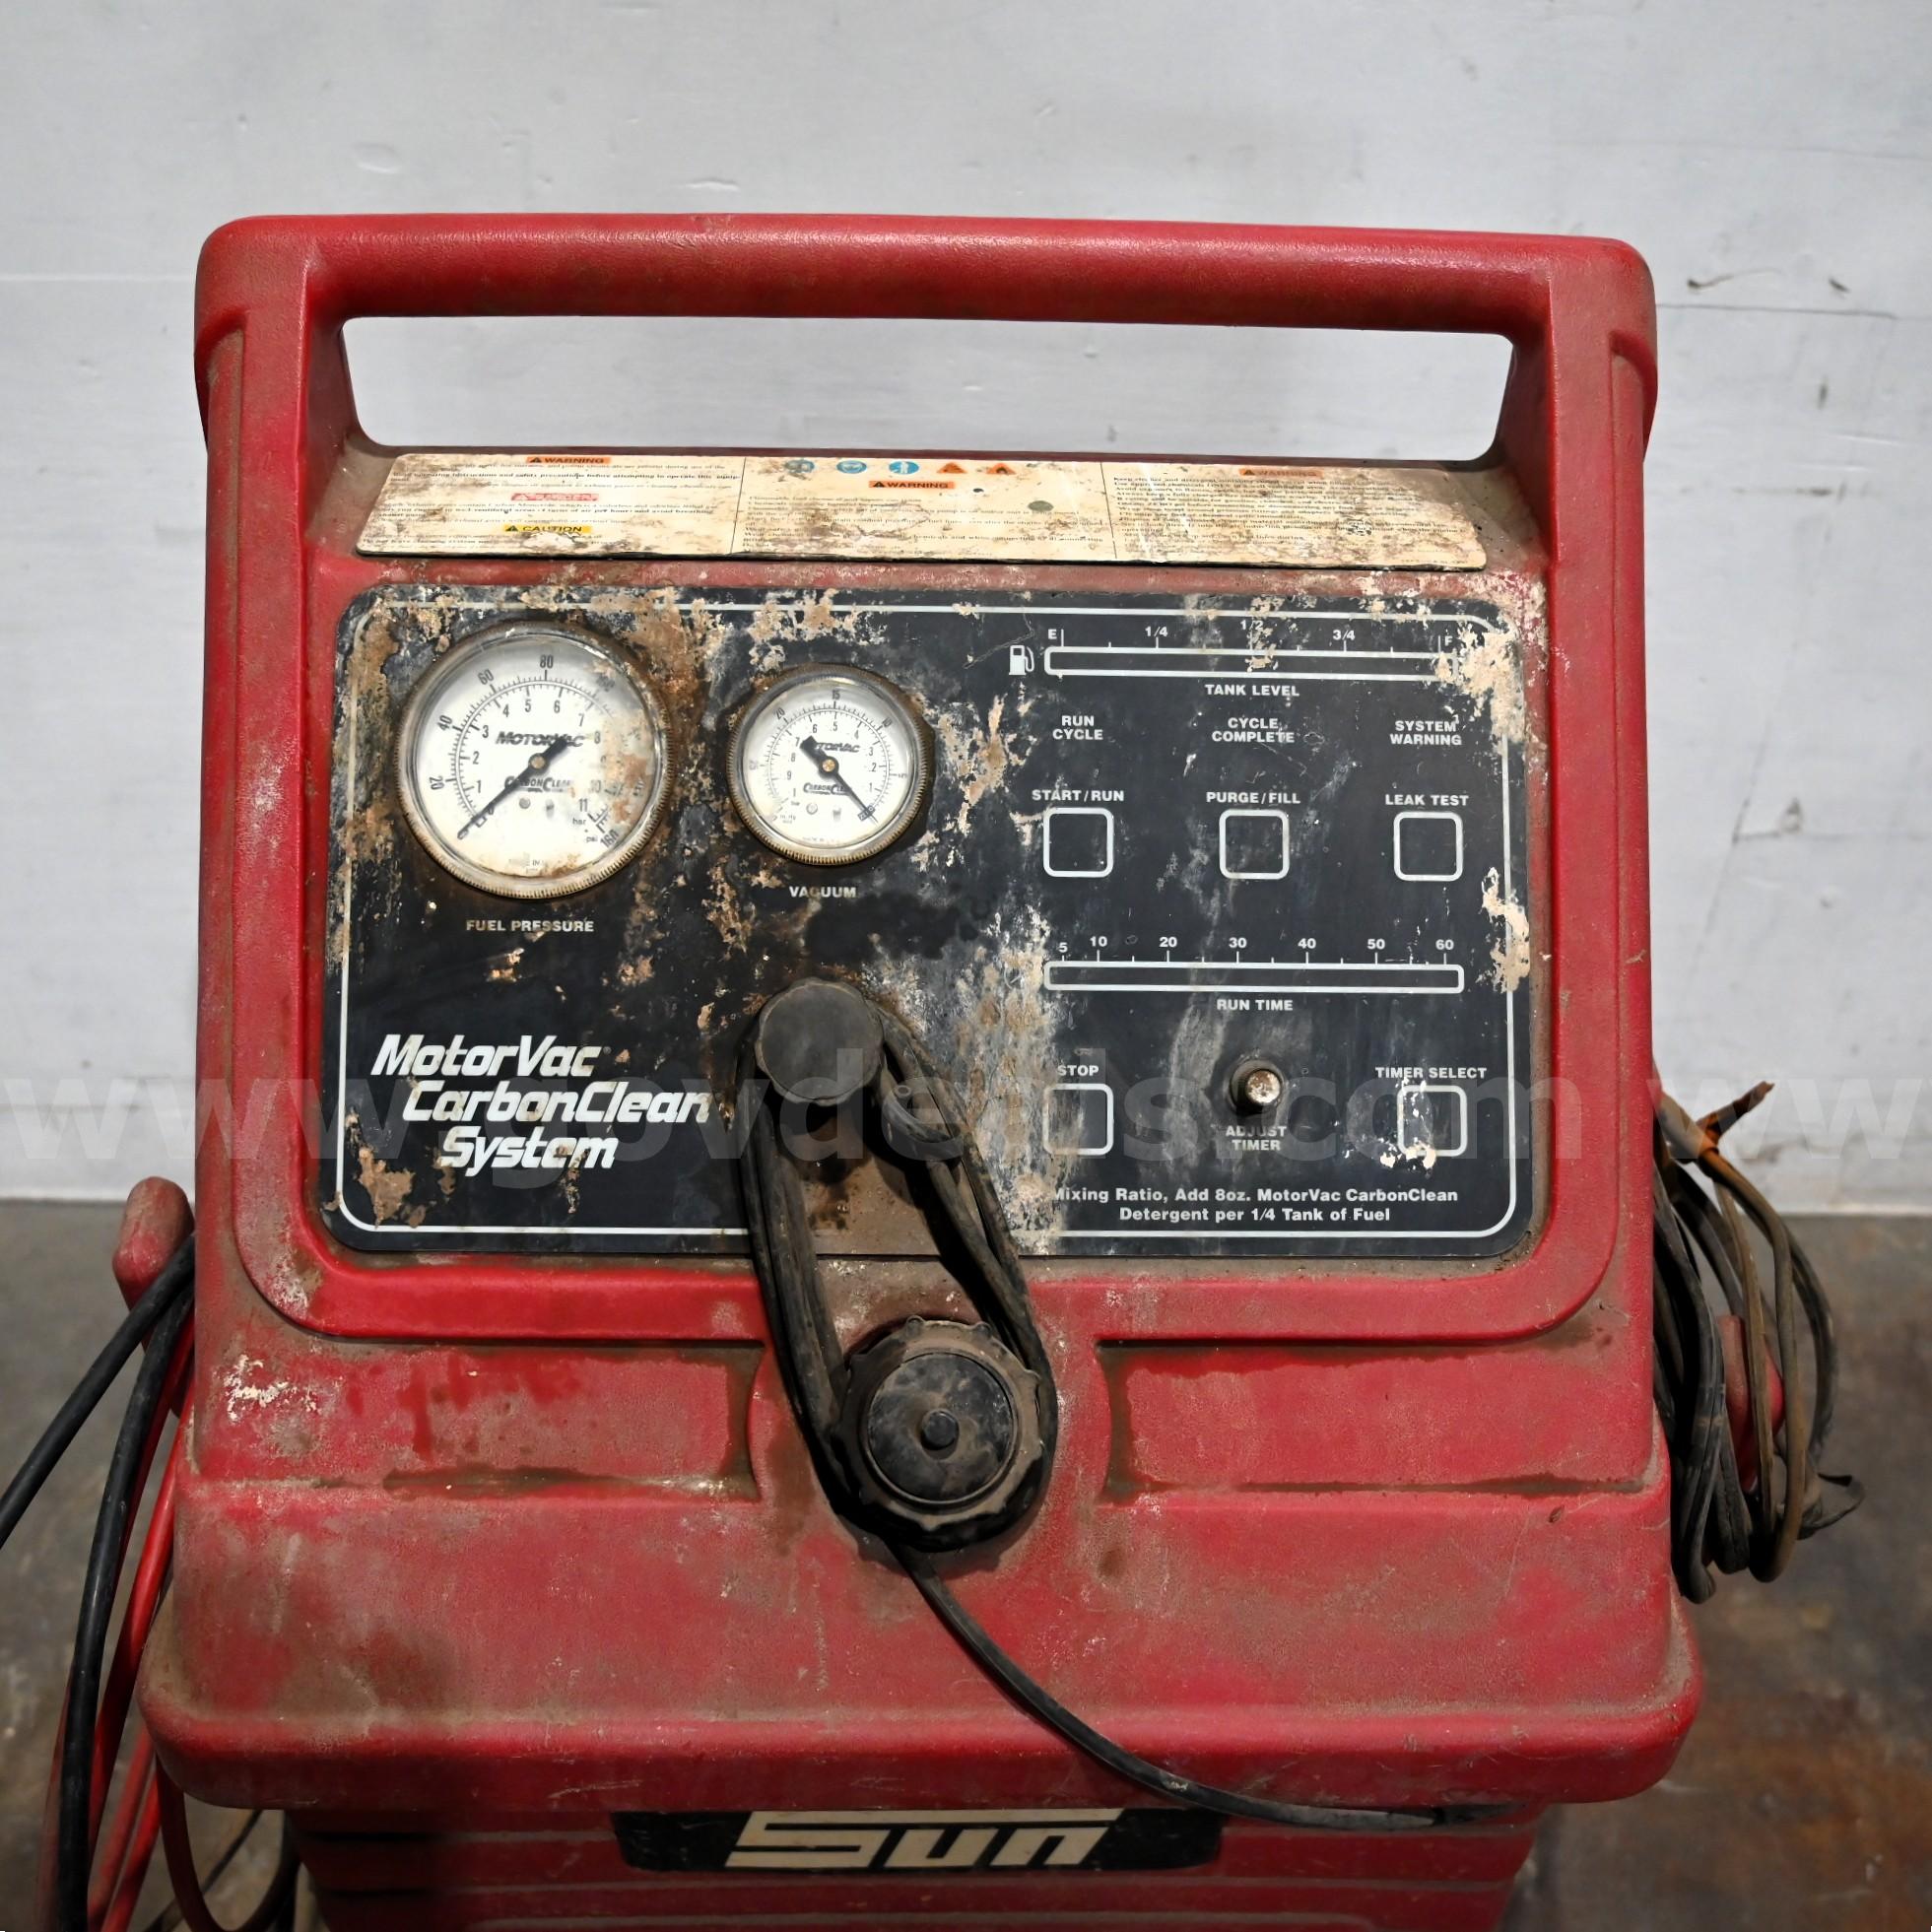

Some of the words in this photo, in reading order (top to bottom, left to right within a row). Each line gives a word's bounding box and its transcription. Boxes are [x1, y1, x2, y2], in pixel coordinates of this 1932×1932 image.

[1047, 629, 1057, 640] E
[1145, 626, 1168, 637] 1/4
[1332, 630, 1356, 640] 3/4
[540, 654, 554, 669] 80
[477, 669, 495, 685] 60
[1205, 684, 1246, 696] TANK
[1251, 685, 1299, 697] LEVEL
[502, 703, 510, 718] 4
[524, 699, 532, 712] 5
[553, 700, 561, 713] 6
[436, 714, 453, 731] 40
[578, 713, 584, 727] 7
[1061, 715, 1095, 727] RUN
[1228, 717, 1279, 729] CYCLE
[1395, 720, 1457, 732] SYSTEM
[482, 724, 490, 739] 3
[1052, 728, 1103, 741] CYCLE
[1212, 730, 1296, 743] COMPLETE
[1390, 733, 1462, 746] WARNING
[473, 751, 480, 765] 2
[429, 775, 444, 790] 20
[1385, 794, 1426, 806] LEAK
[1431, 794, 1469, 807] TEST
[788, 886, 857, 899] VACUUM
[466, 920, 506, 932] FUEL
[510, 921, 594, 933] PRESSURE
[1059, 942, 1068, 953] 5
[1090, 936, 1107, 947] 10
[1159, 936, 1177, 948] 20
[1229, 937, 1247, 949] 30
[1298, 938, 1316, 949] 40
[1366, 939, 1386, 950] 50
[1435, 939, 1454, 951] 60
[1217, 998, 1250, 1011] RUN
[1255, 999, 1293, 1011] TIME
[370, 1034, 601, 1077] MotorVac
[1057, 1064, 1099, 1077] STOP
[1375, 1066, 1424, 1079] TIMER
[1429, 1067, 1487, 1080] SELECT
[402, 1080, 712, 1123] CarbonClean
[1226, 1125, 1287, 1137] ADJUST
[442, 1126, 619, 1176] System
[1232, 1139, 1281, 1152] TIMER
[1054, 1187, 1109, 1204] Mixing
[1115, 1187, 1168, 1203] Ratio,
[1174, 1187, 1209, 1202] Add
[1215, 1188, 1251, 1202] 8oz.
[1257, 1188, 1341, 1202] MotorVac
[1346, 1188, 1458, 1202] CarbonClean
[1119, 1207, 1209, 1223] Detergent
[1215, 1210, 1244, 1223] per
[1251, 1208, 1275, 1222] 1/4
[1282, 1208, 1323, 1222] Tank
[1330, 1208, 1347, 1222] of
[1353, 1208, 1390, 1222] Fuel
